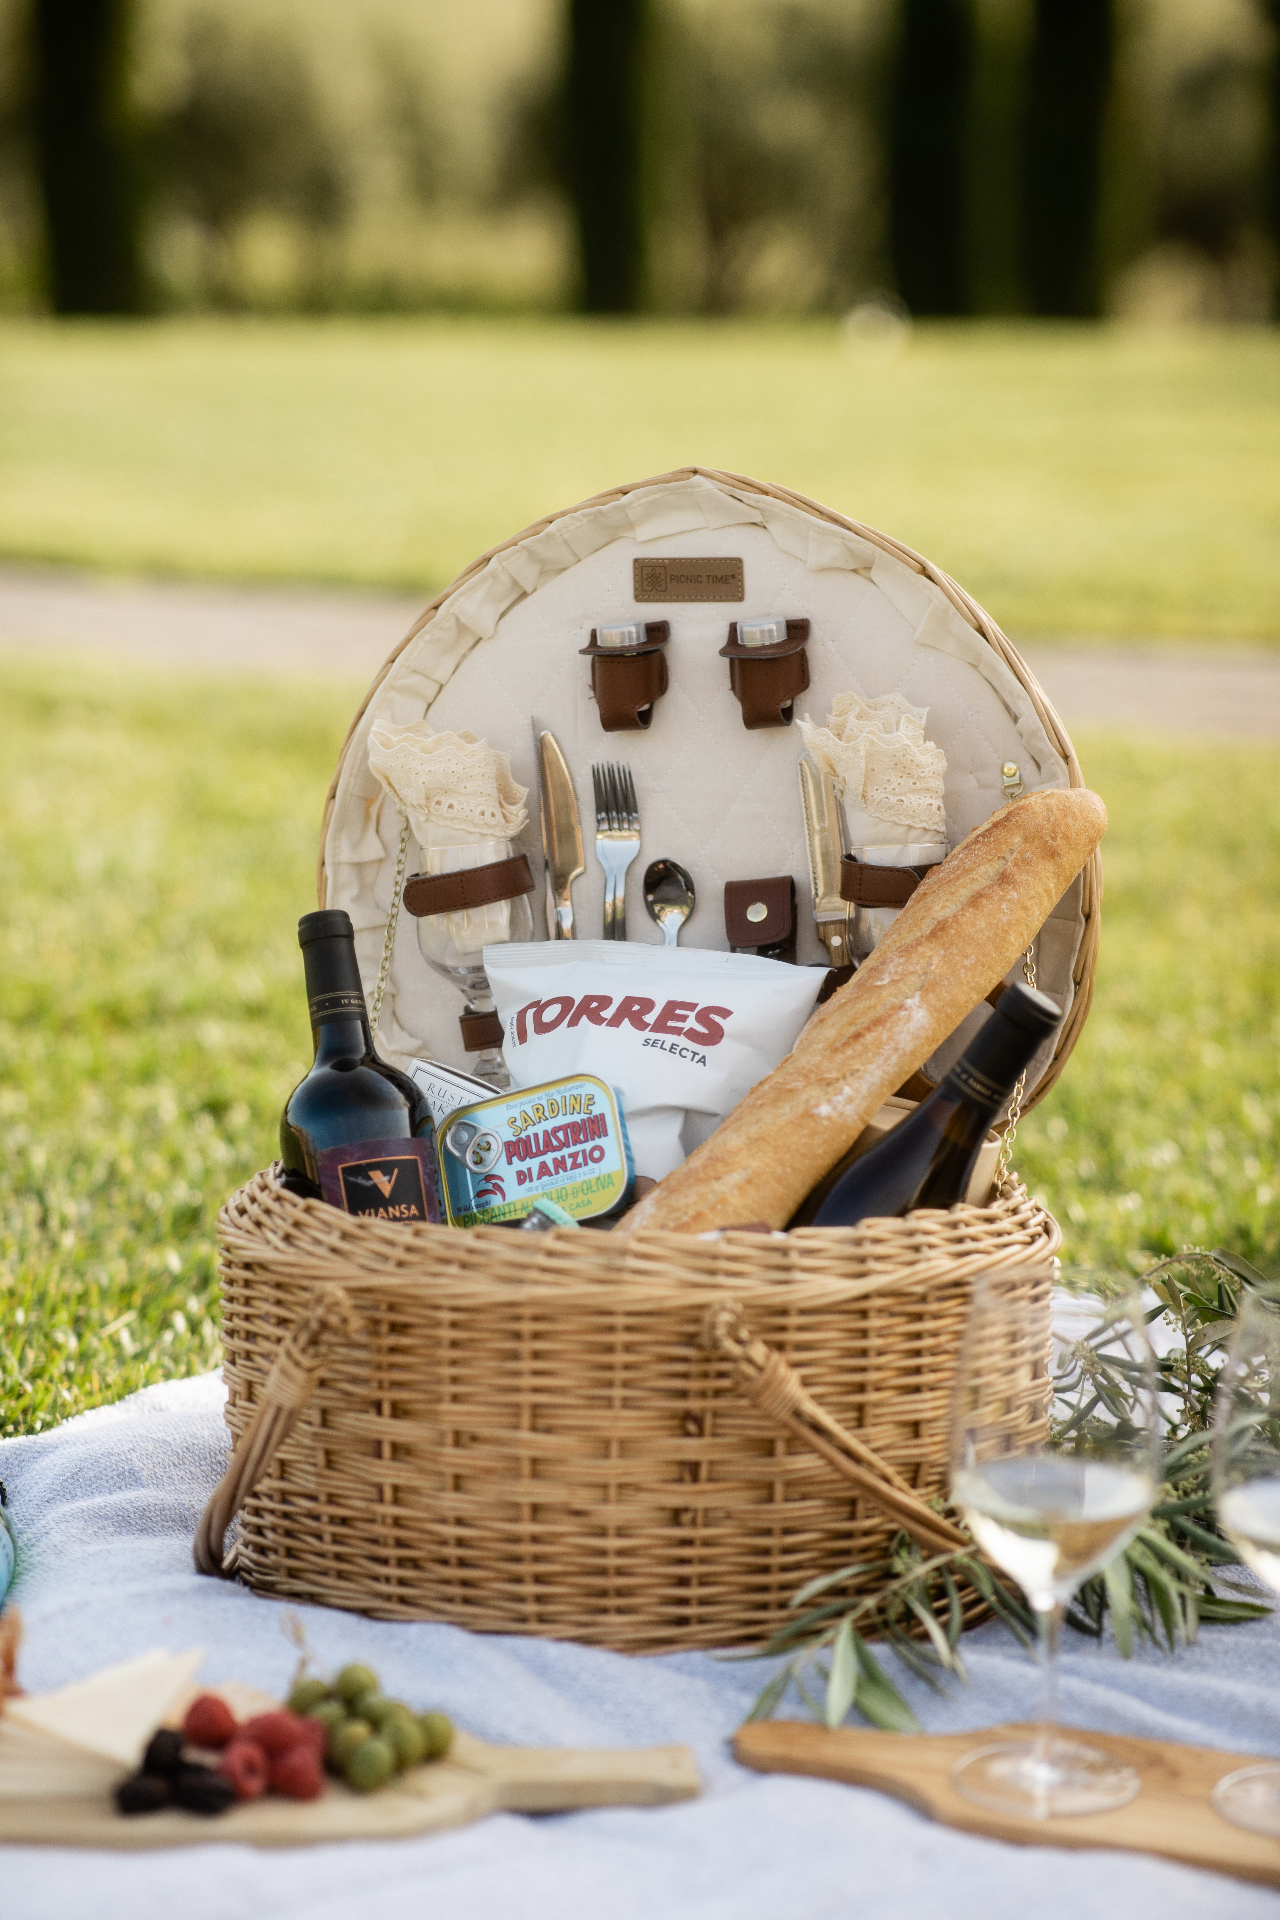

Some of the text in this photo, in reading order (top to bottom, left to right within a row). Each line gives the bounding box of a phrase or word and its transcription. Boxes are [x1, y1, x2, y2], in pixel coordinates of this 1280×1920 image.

[669, 574, 703, 584] PICNIC
[516, 994, 734, 1047] TORRES
[642, 1038, 707, 1067] SELECTA
[507, 1093, 595, 1137] SARDINE
[504, 1112, 609, 1166] POLLASTRINI
[516, 1144, 605, 1187] DI ANZIO
[357, 1203, 420, 1219] VIANSA
[568, 1198, 593, 1211] CASA
